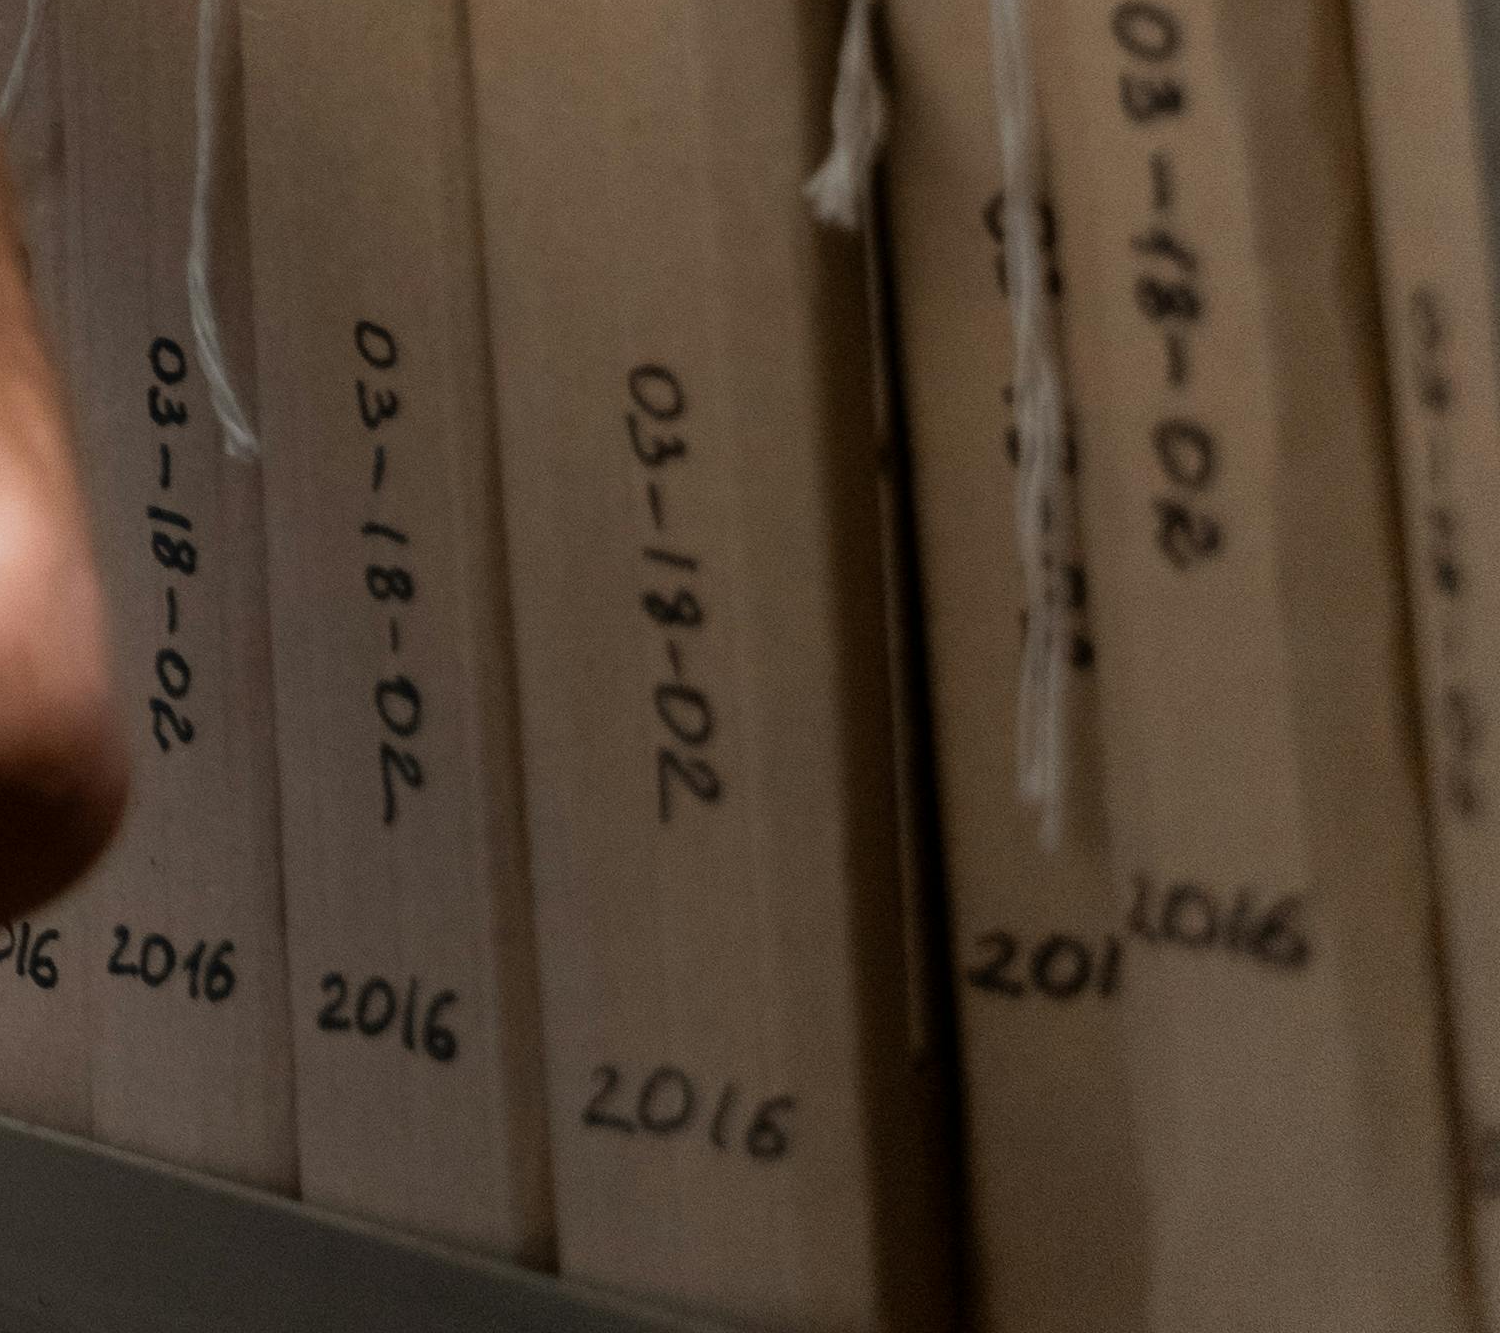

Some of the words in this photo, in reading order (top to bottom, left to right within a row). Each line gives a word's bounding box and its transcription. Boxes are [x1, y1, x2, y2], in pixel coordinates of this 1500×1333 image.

[147, 335, 198, 754] 03-18-02
[355, 318, 423, 828] 03-18-02
[626, 362, 723, 825] 03-18-02
[106, 924, 238, 1004] 2016
[316, 971, 459, 1063] 2016
[583, 1063, 796, 1163] 2016
